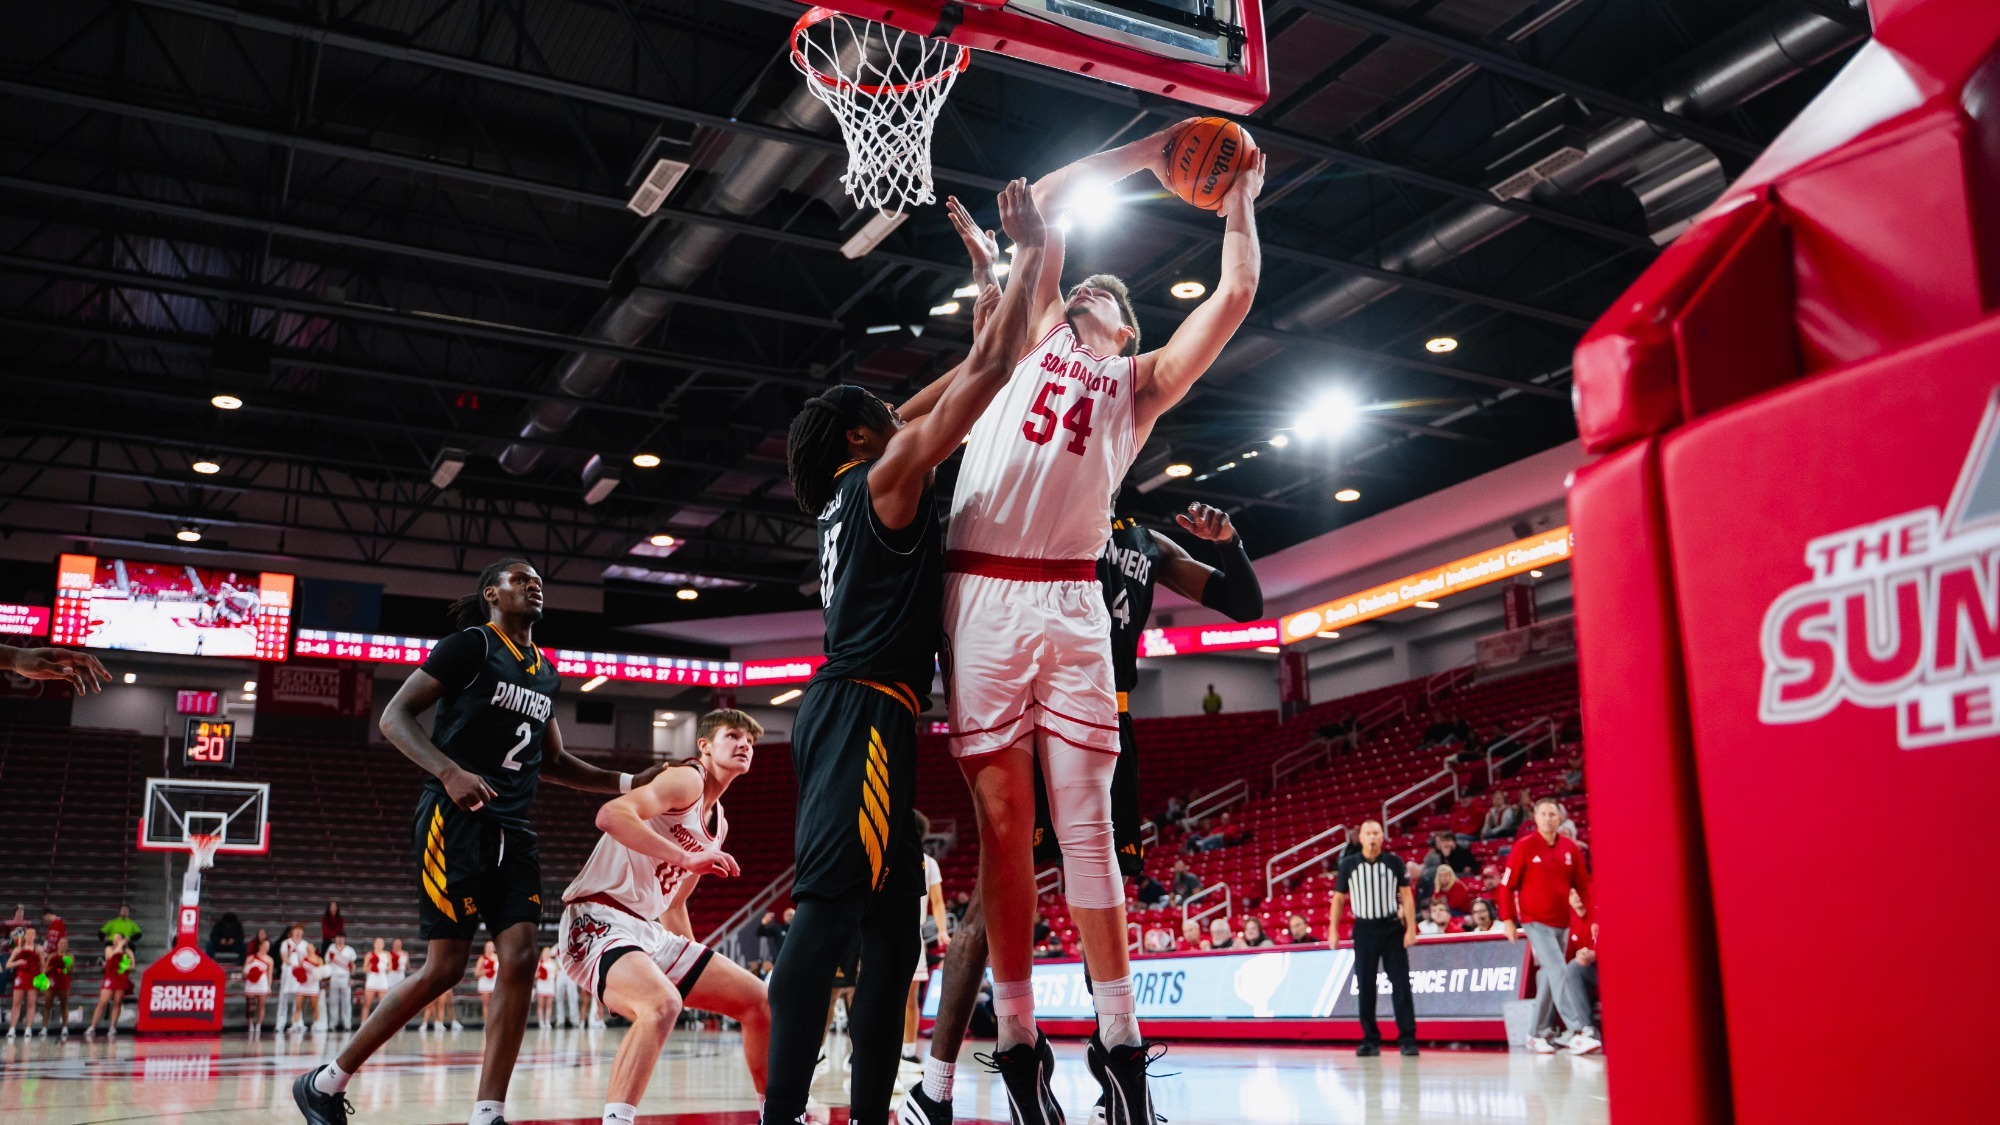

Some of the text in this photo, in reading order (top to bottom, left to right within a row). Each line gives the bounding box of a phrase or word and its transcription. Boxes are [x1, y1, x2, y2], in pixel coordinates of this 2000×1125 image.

[1201, 137, 1238, 195] Wilson
[1022, 381, 1095, 457] 54
[1813, 515, 1934, 579] THE
[1325, 603, 1358, 623] South
[1358, 591, 1399, 614] Dakota
[1507, 538, 1568, 566] Cleaning
[279, 682, 339, 696] DAKOTA
[280, 671, 340, 685] SOUTH
[194, 736, 225, 761] 20
[501, 721, 532, 771] 2
[151, 985, 216, 999] SOUTH
[1133, 970, 1186, 1005] ORTS
[1449, 968, 1469, 993] IT
[1470, 966, 1518, 993] LIVE!
[150, 998, 215, 1011] DAKOTA
